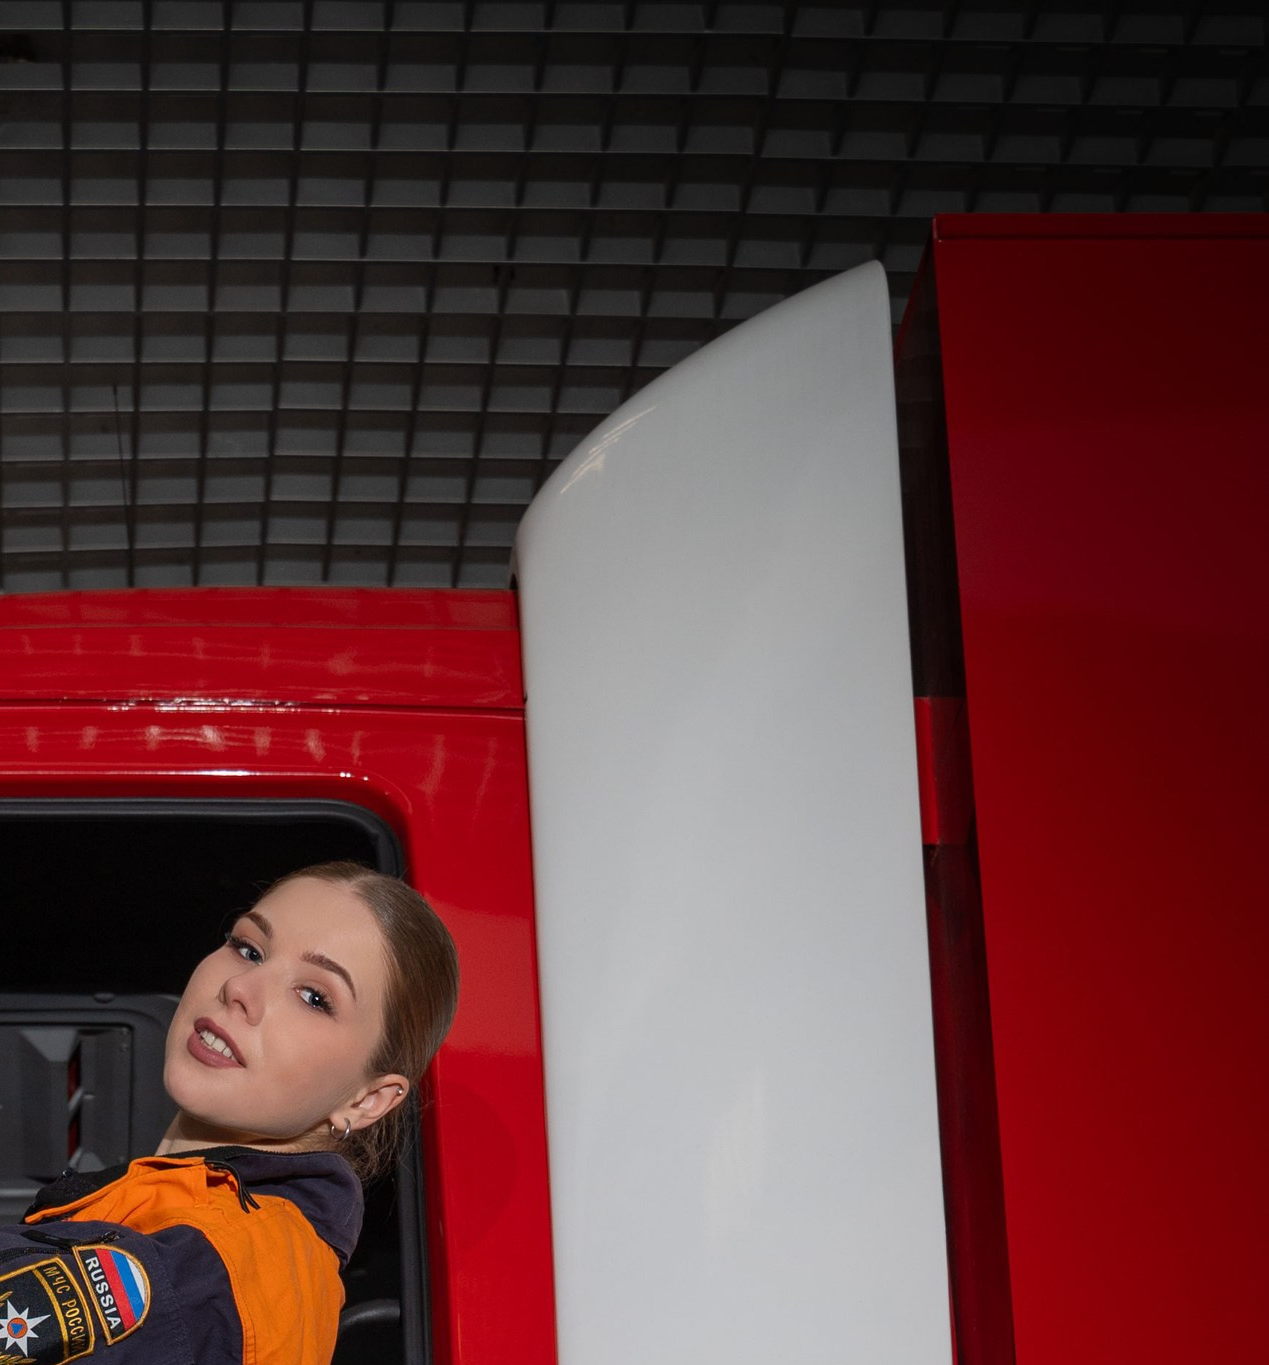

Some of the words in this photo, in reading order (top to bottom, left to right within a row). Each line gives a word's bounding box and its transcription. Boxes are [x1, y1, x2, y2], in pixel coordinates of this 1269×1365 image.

[43, 1266, 70, 1294] МЧС
[62, 1298, 85, 1354] РОССИИ
[85, 1256, 122, 1330] RUSSIA
